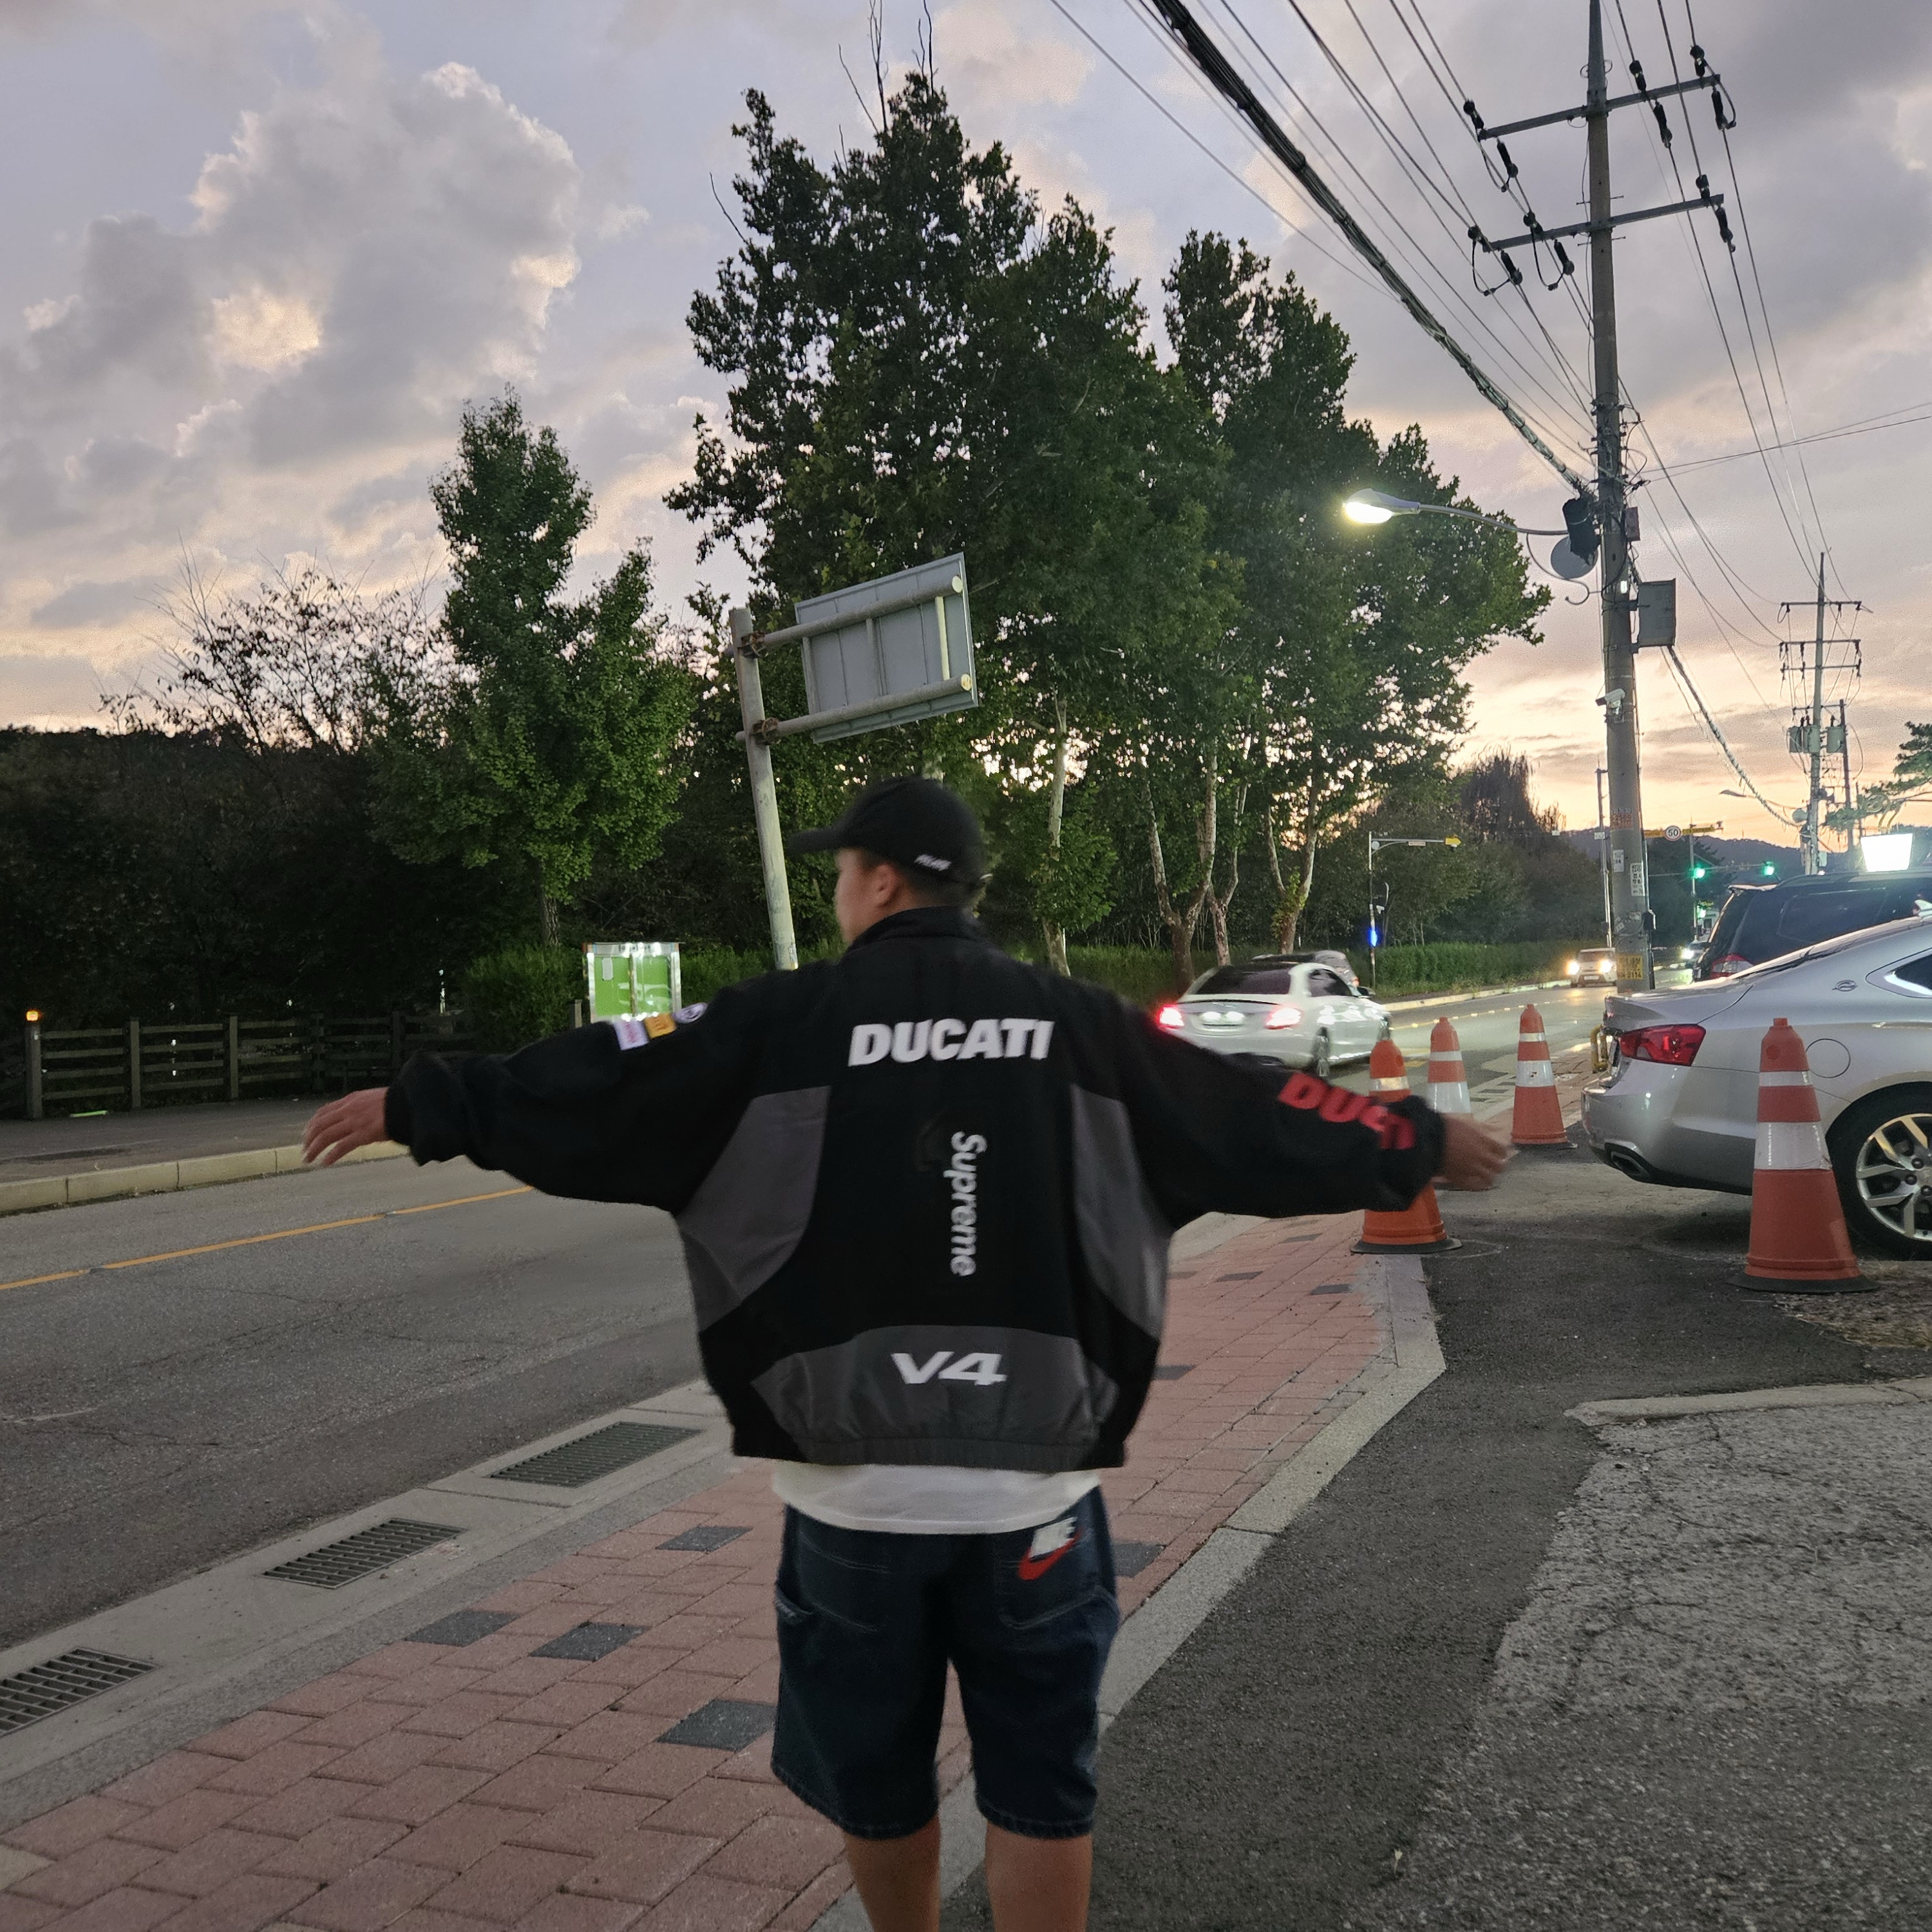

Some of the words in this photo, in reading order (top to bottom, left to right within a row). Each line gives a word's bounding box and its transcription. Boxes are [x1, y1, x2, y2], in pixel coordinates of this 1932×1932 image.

[1668, 828, 1679, 837] 50
[848, 1018, 1055, 1066] DUCATI
[943, 1130, 987, 1276] Supreme
[890, 1351, 1008, 1386] V4
